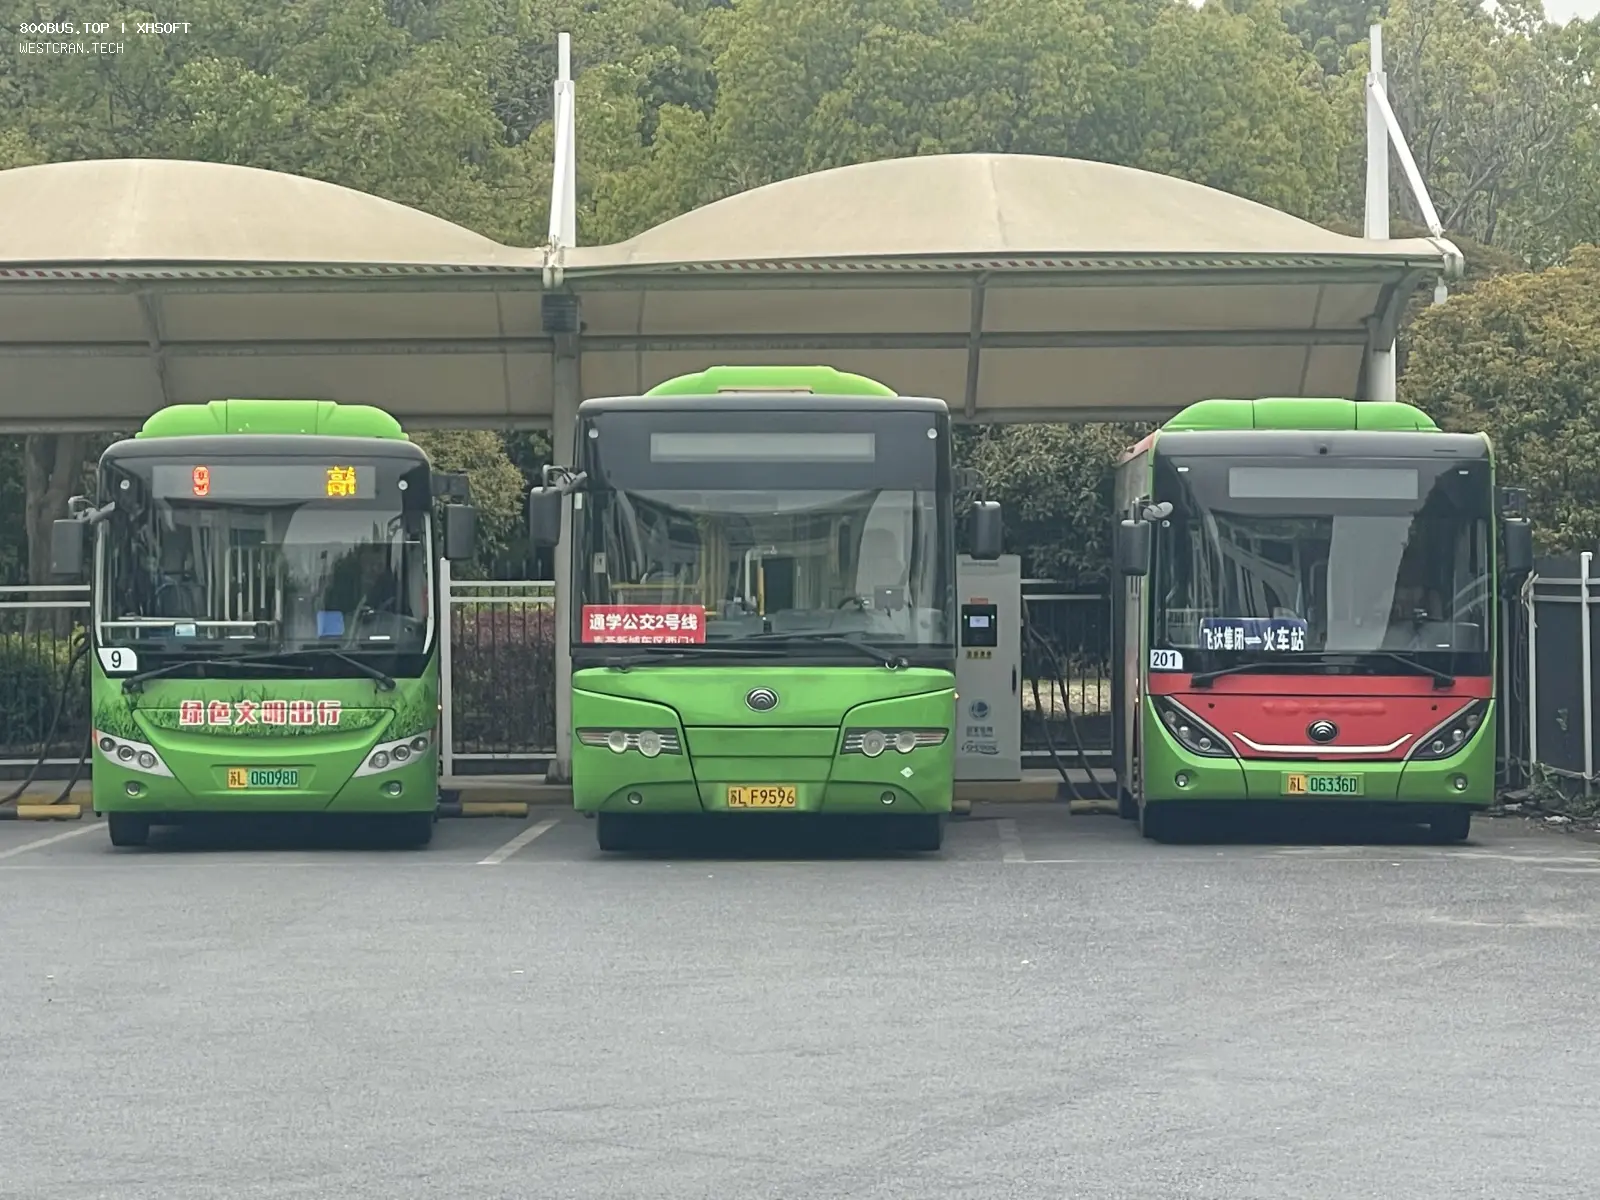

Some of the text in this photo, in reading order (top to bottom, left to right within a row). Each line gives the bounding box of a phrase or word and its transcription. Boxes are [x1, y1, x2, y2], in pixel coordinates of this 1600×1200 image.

[193, 466, 209, 496] 9
[589, 613, 698, 631] 通学公交2号线
[1263, 627, 1304, 652] 火车站
[111, 650, 122, 669] 9
[1152, 651, 1177, 667] 201
[179, 699, 342, 725] 绿色文明出行
